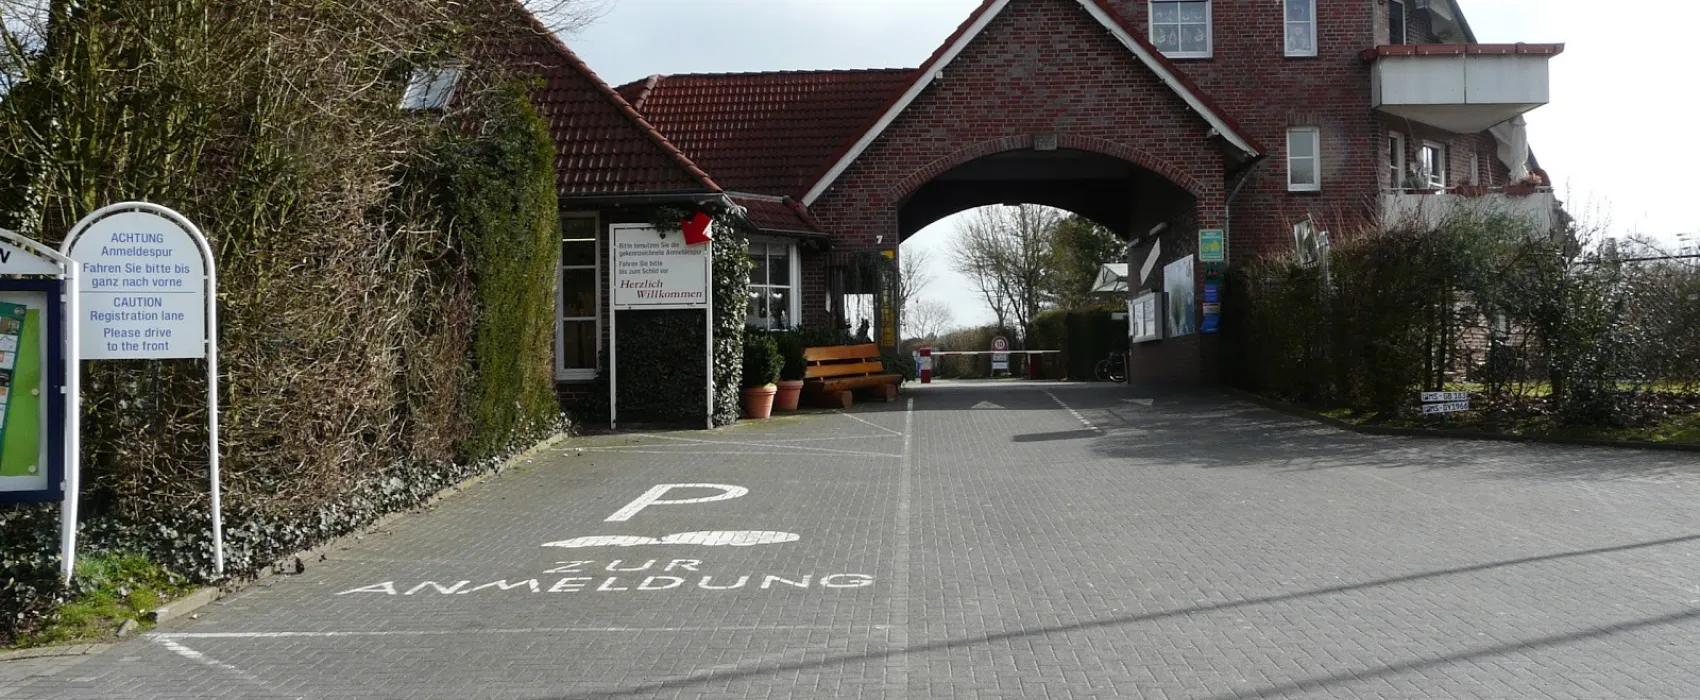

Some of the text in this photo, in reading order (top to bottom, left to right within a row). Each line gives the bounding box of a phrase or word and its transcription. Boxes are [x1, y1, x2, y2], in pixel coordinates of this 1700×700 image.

[111, 232, 164, 243] ACHTUNG
[876, 235, 883, 244] 7
[101, 246, 173, 258] Anmeldespur
[83, 262, 190, 274] Fahren Sie bitte bis
[92, 277, 183, 289] ganz nach vorne
[620, 279, 663, 289] Herzlich
[636, 290, 702, 299] Willkommen
[113, 297, 162, 308] CAUTION
[90, 311, 185, 323] Registration lane
[103, 328, 172, 338] Please drive
[107, 341, 169, 352] to the front
[604, 483, 749, 521] P
[542, 558, 703, 574] ZUR
[334, 573, 875, 596] ANMELDUNG
